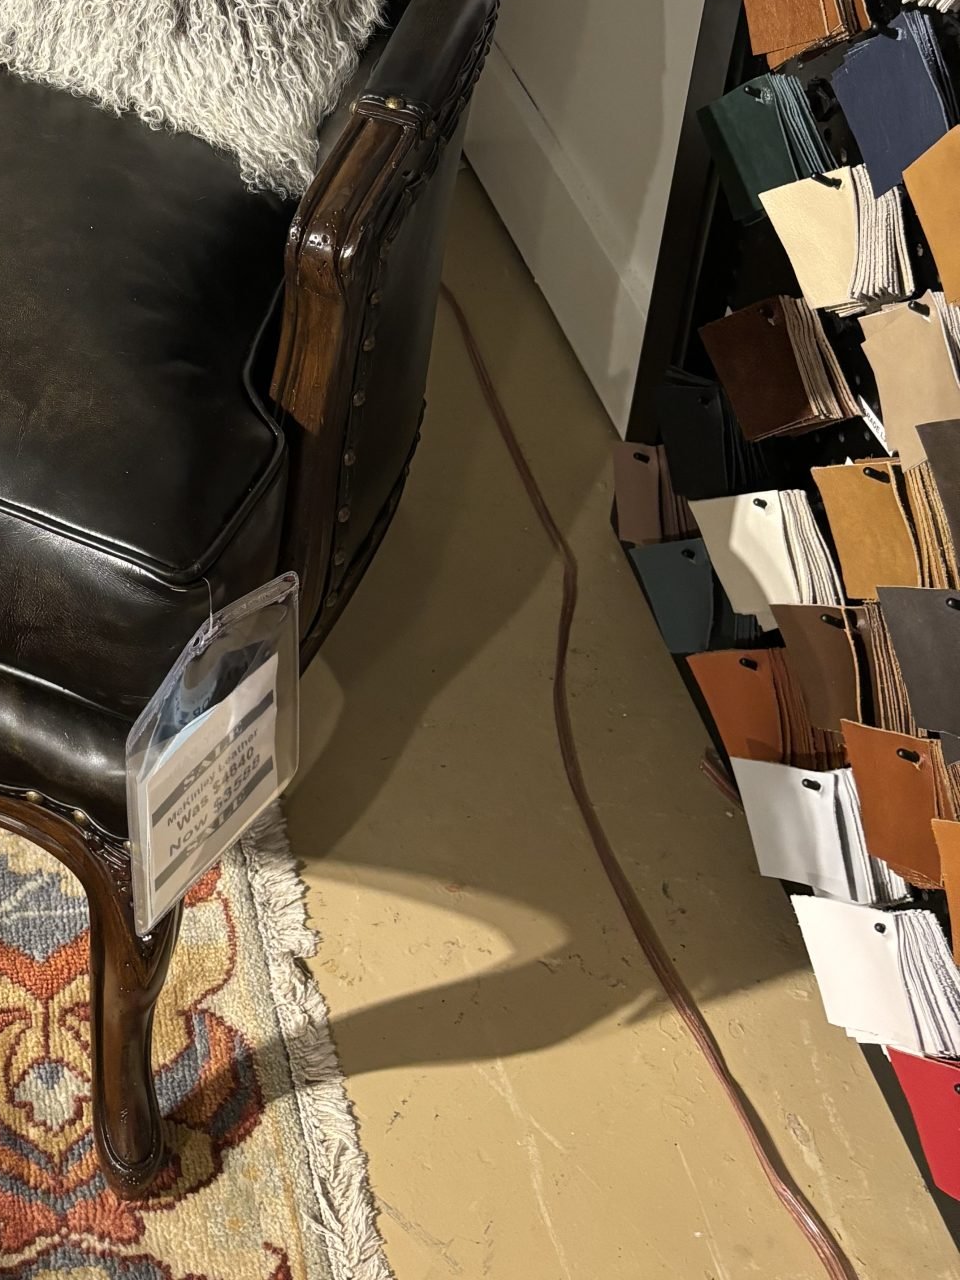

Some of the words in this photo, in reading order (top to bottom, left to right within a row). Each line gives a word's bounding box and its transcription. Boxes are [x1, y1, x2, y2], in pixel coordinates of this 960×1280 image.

[167, 772, 215, 827] McKinley
[218, 729, 258, 769] Leather
[169, 812, 209, 857] Now
[176, 796, 210, 832] Was
